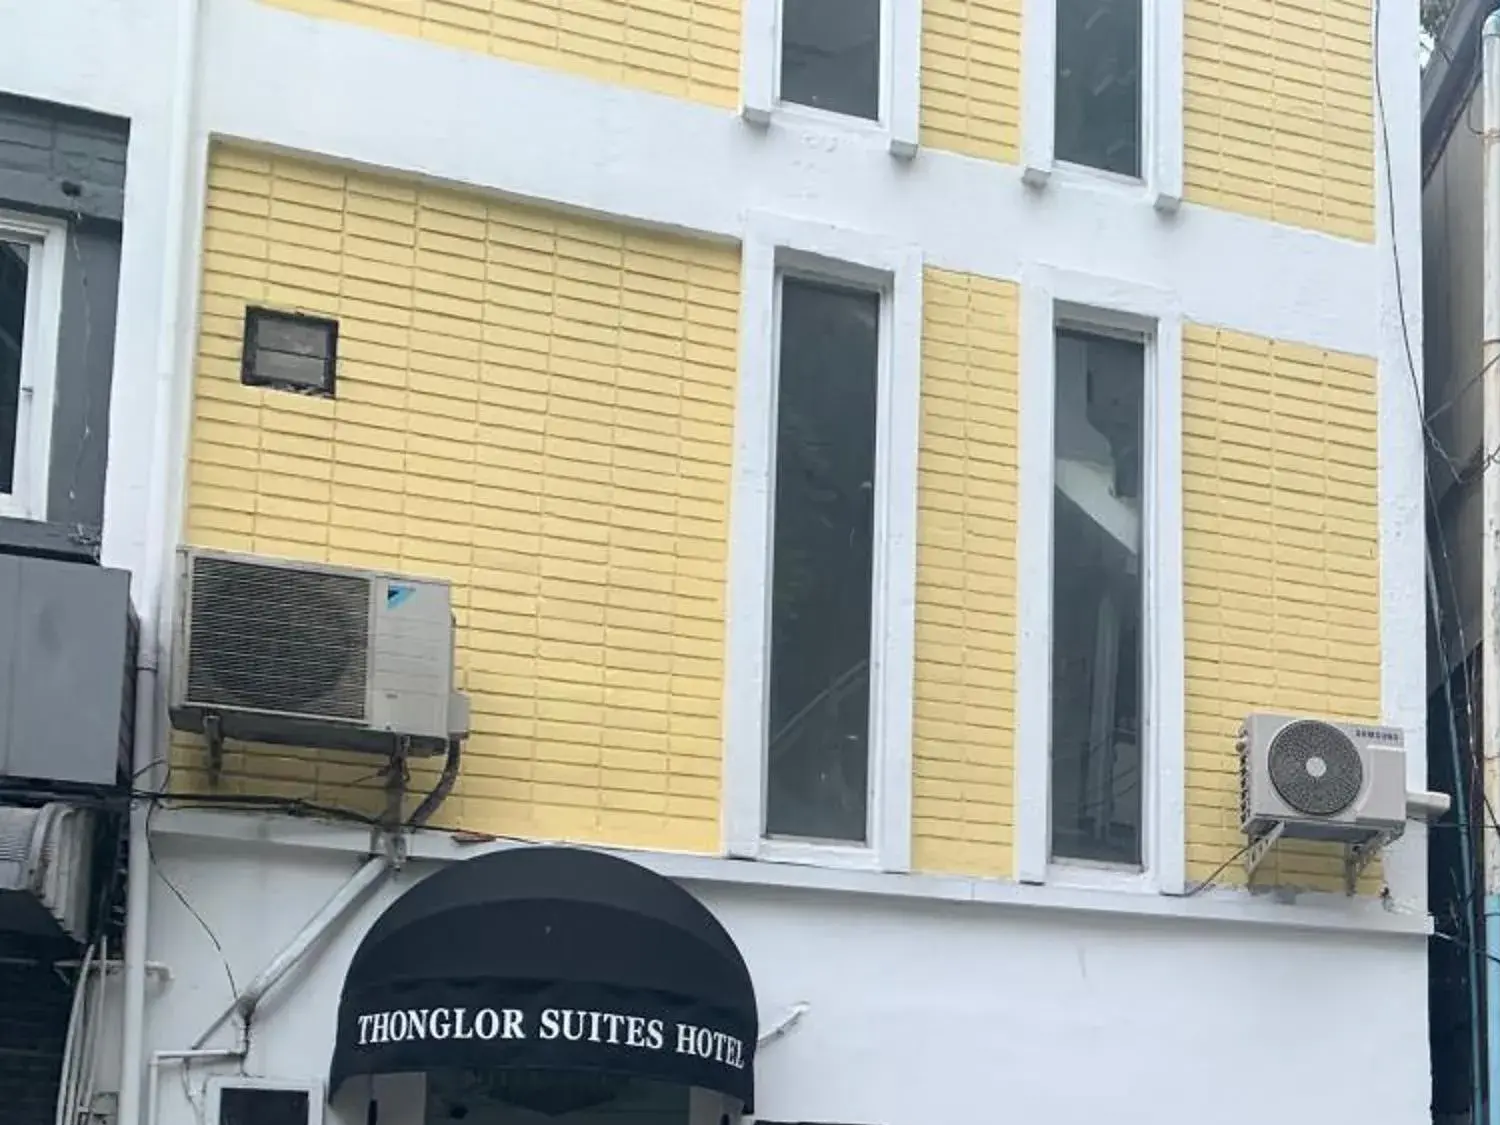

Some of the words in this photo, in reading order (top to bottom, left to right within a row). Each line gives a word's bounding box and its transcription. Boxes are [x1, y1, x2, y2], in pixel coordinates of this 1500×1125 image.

[357, 1007, 526, 1045] THONGLOR
[539, 1008, 664, 1049] SUITES
[676, 1022, 745, 1070] HOTEL
